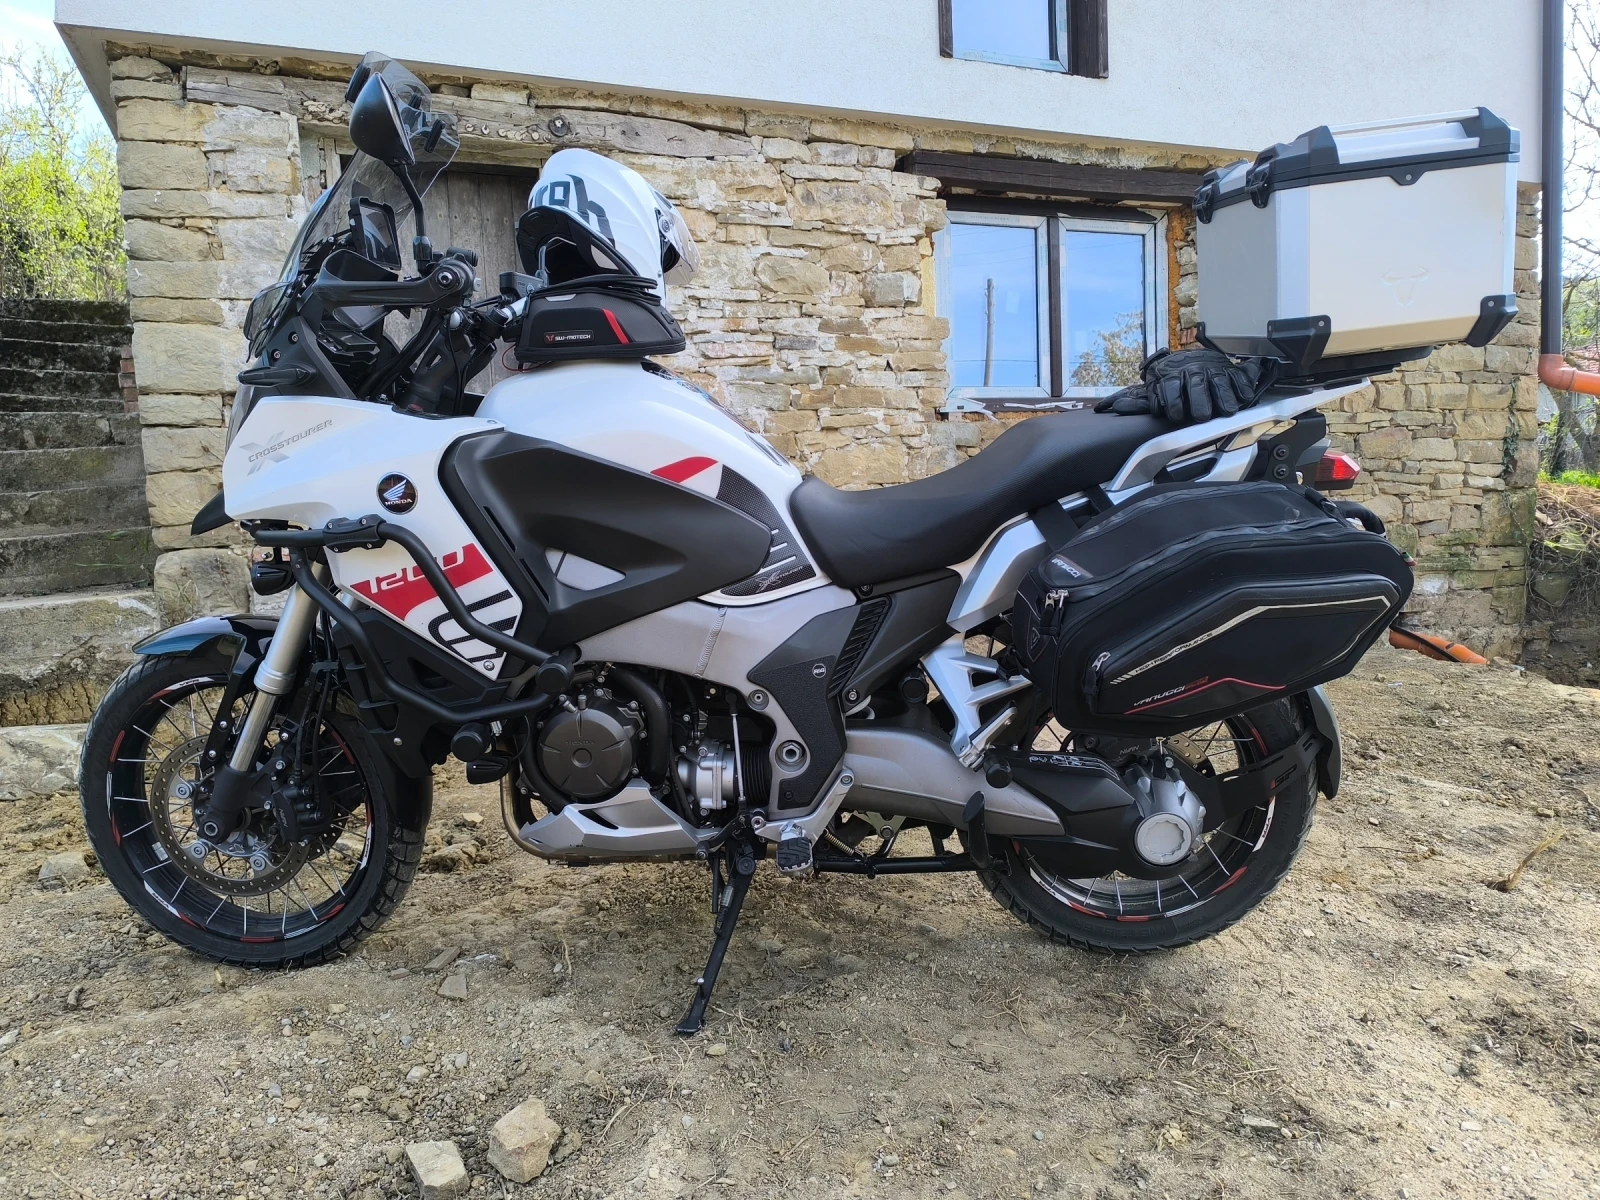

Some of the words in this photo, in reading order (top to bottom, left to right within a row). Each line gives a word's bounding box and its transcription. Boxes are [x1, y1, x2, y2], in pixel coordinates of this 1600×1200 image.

[555, 333, 591, 342] SW-MOTECH
[248, 418, 333, 463] CROSSTOURER
[384, 497, 413, 506] HONDA
[1153, 632, 1213, 664] PERFORMANCE
